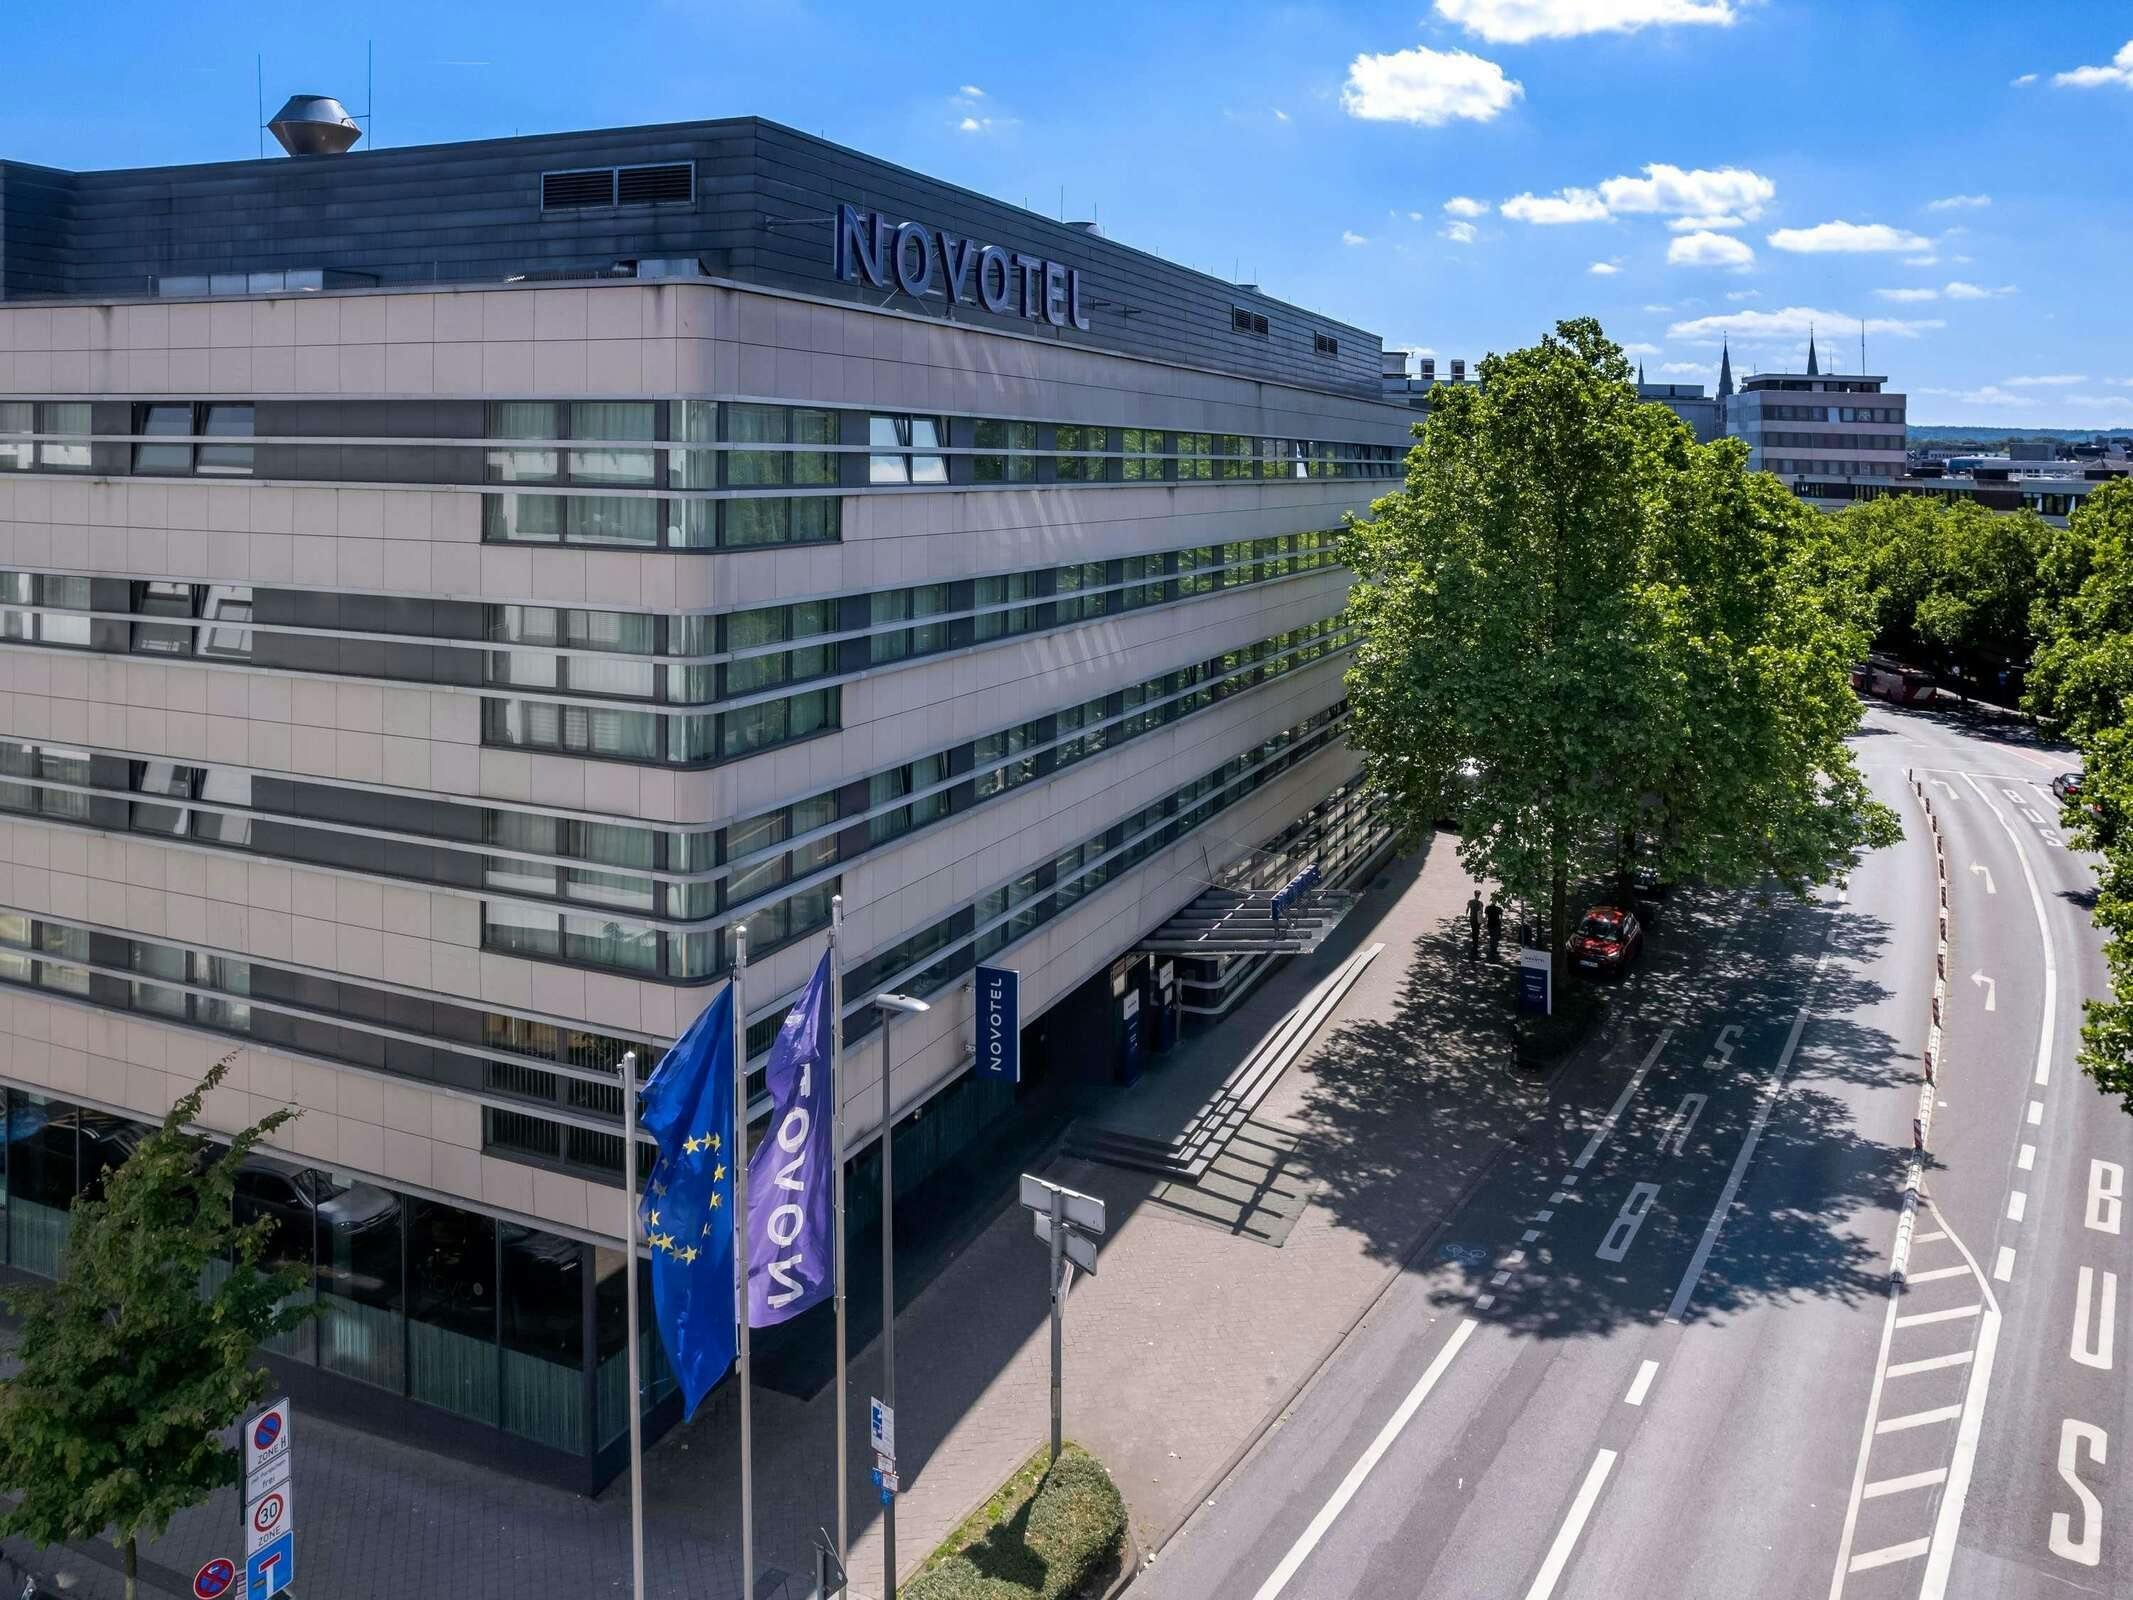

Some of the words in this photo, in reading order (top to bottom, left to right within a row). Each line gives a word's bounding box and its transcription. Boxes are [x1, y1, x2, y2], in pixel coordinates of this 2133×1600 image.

[836, 203, 1090, 331] NOVOTEL
[2001, 788, 2065, 847] BUS
[990, 977, 1002, 1072] NOVOTEL
[2048, 1158, 2124, 1567] BUS
[257, 1443, 279, 1465] ZONE
[280, 1435, 287, 1449] H
[258, 1525, 281, 1546] ZONE
[260, 1502, 278, 1524] 30
